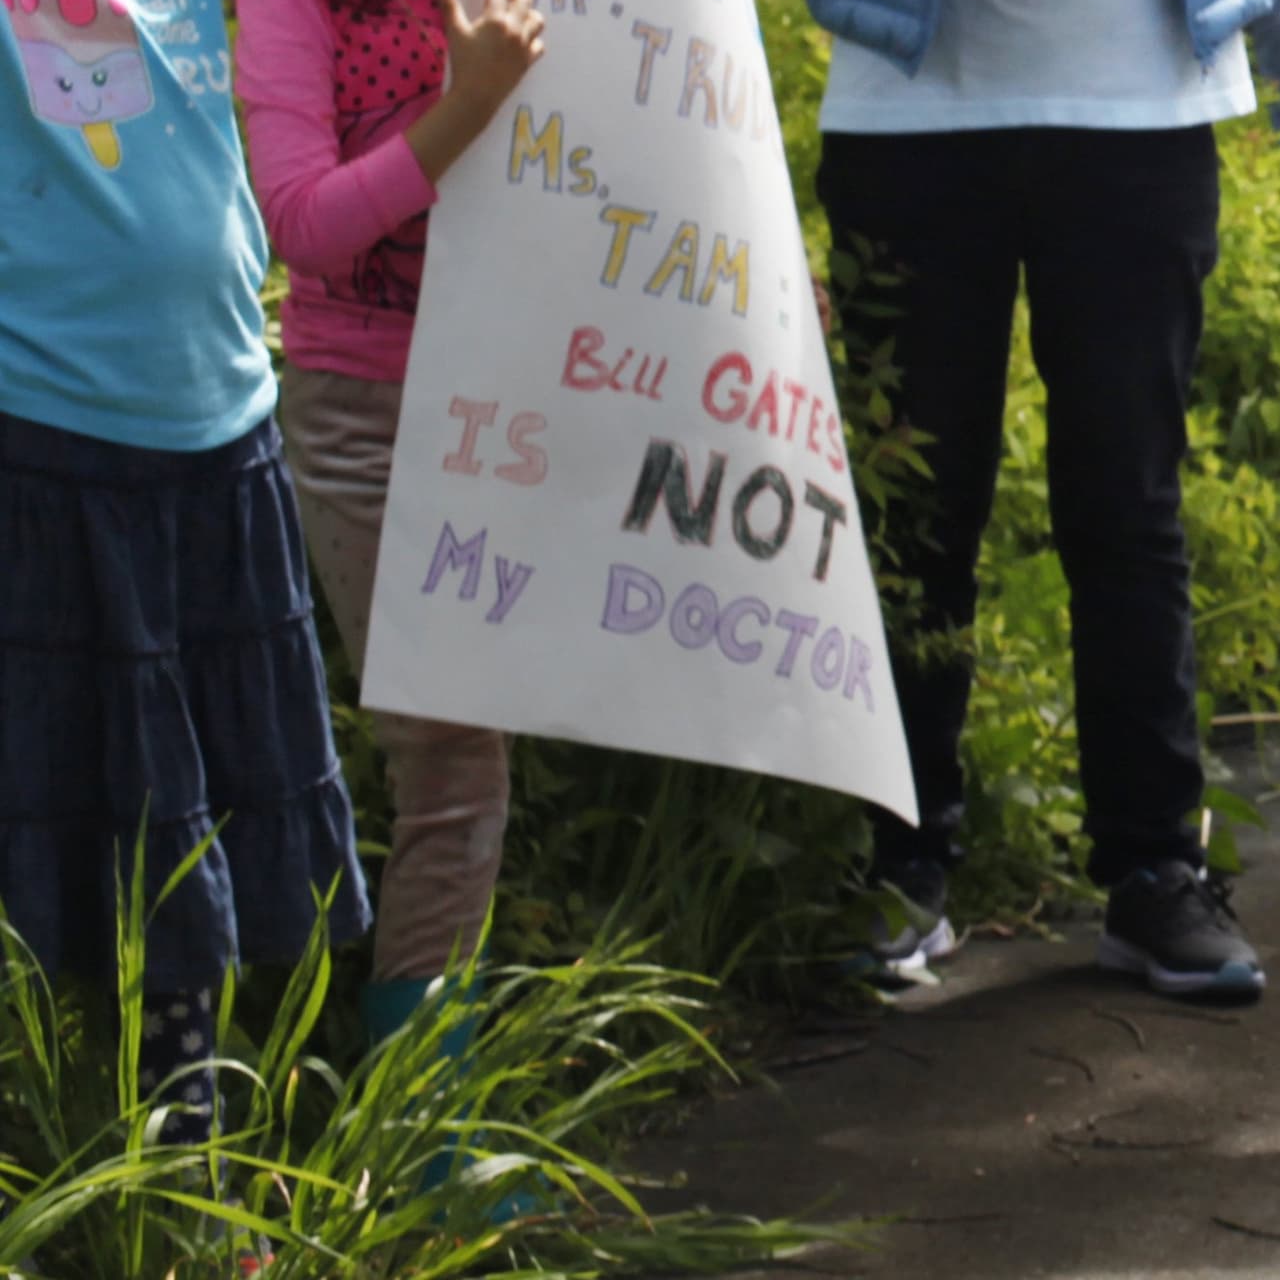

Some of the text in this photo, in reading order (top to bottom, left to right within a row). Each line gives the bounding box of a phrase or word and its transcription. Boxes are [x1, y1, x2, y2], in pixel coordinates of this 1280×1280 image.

[508, 104, 610, 200] Ms.
[701, 350, 847, 474] GATES
[442, 395, 850, 582] IS NOT
[600, 562, 877, 713] DOCTOR
